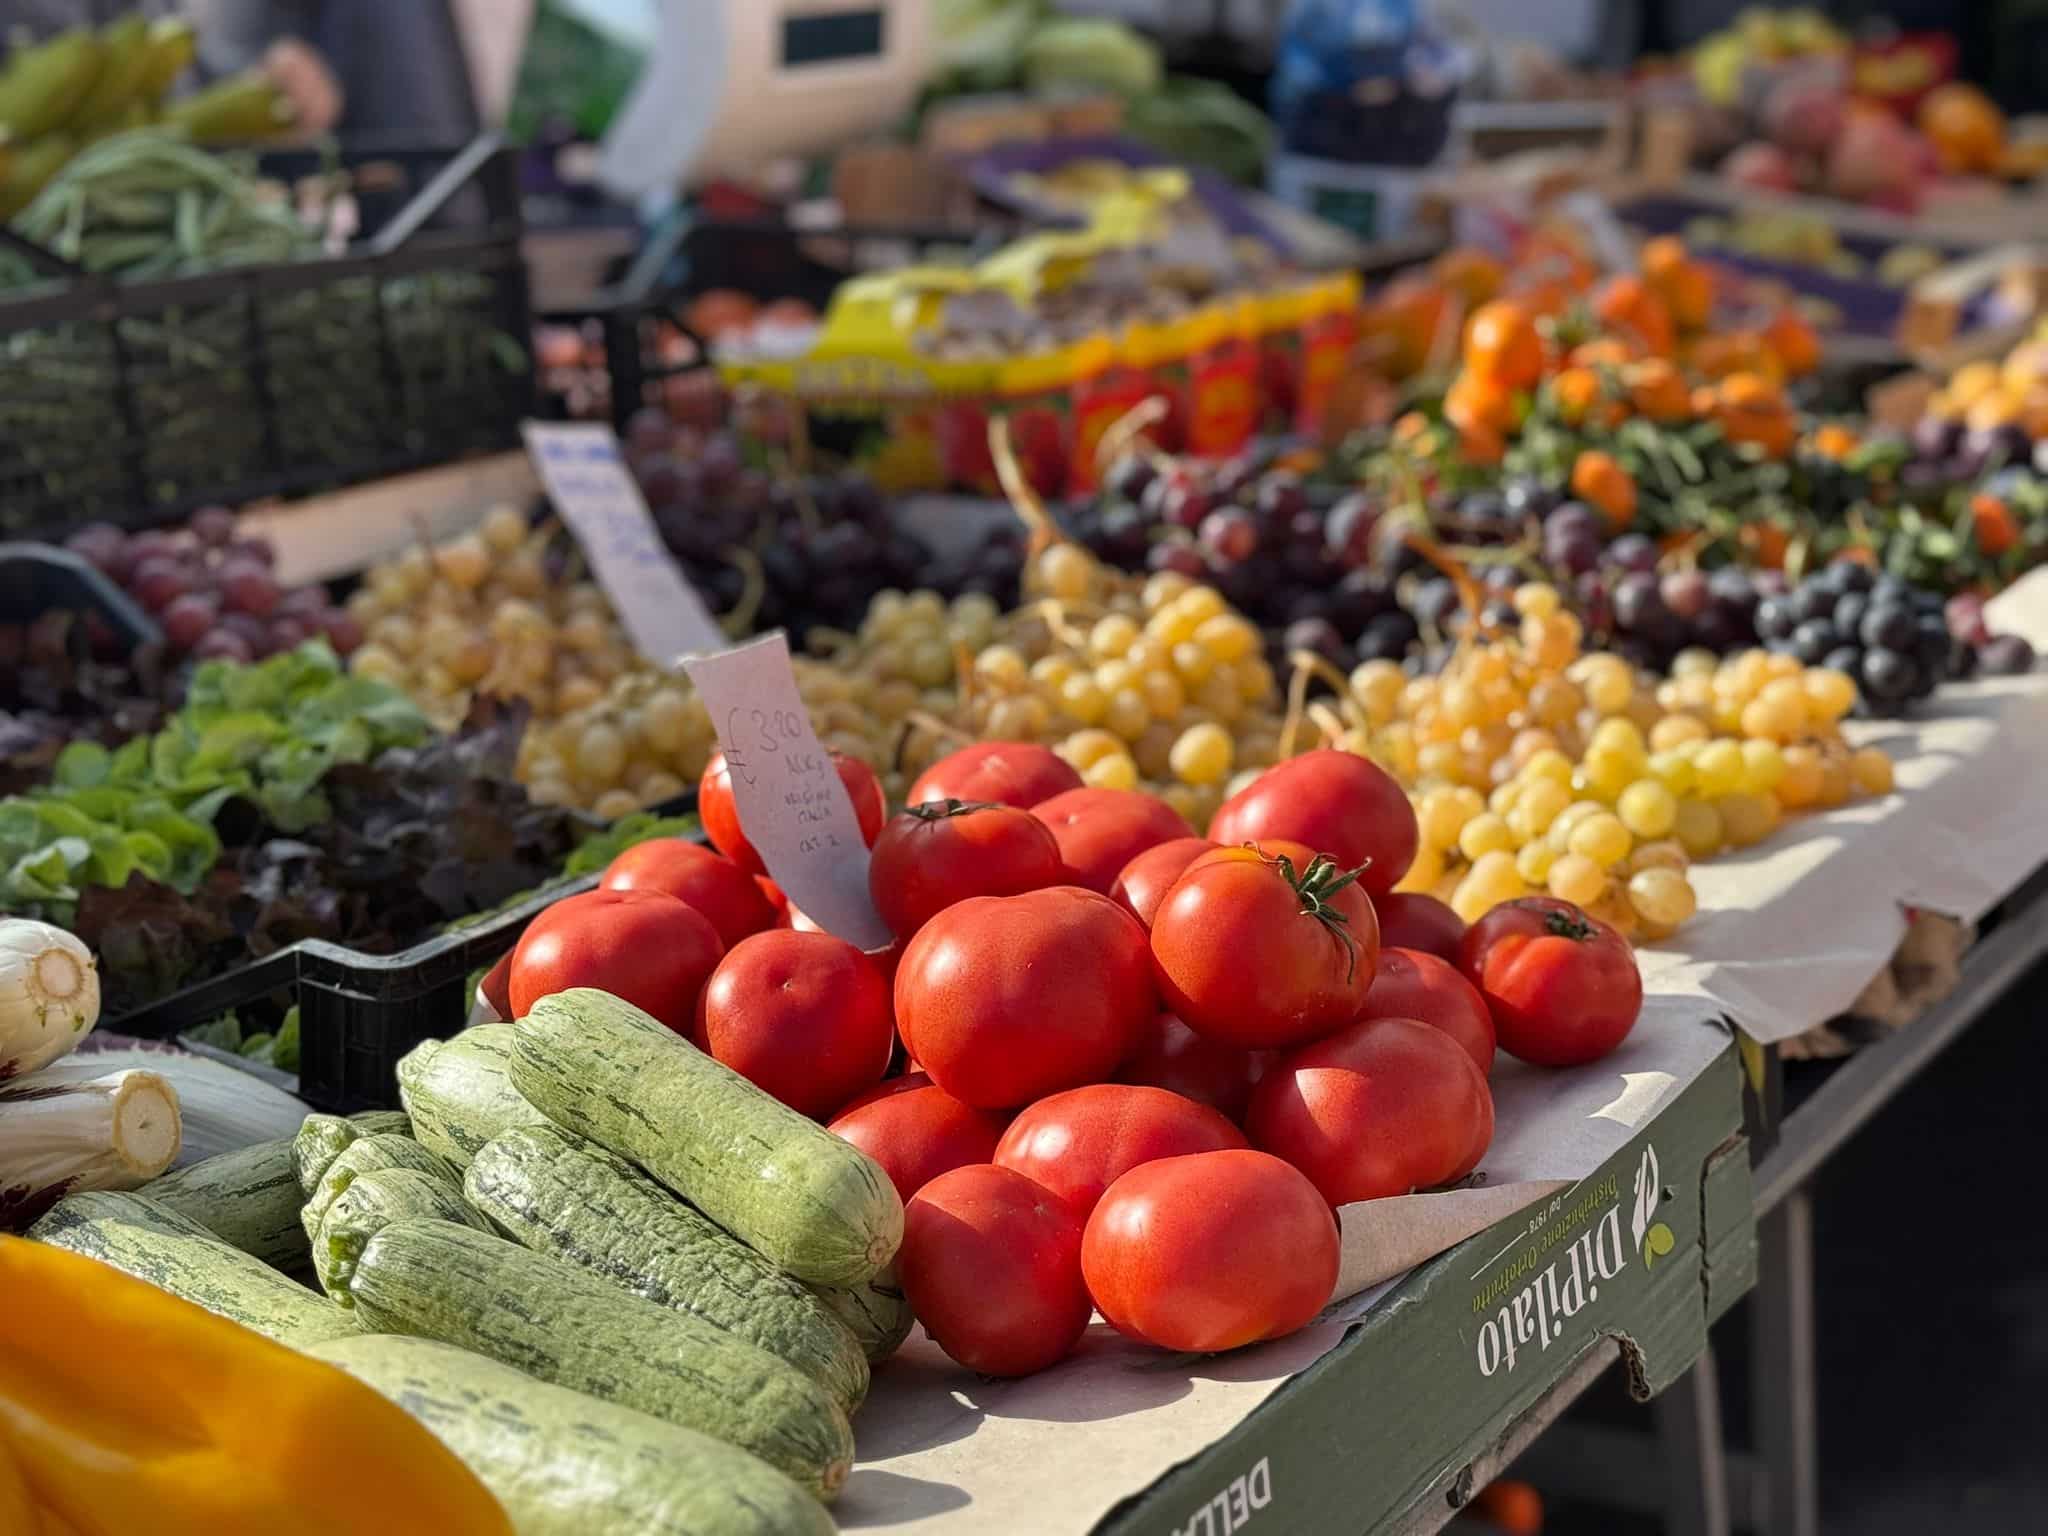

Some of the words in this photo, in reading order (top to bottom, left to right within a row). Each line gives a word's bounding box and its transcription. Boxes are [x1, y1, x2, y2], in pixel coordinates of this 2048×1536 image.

[1528, 1211, 1547, 1235] 1978
[1540, 1173, 1617, 1253] Distribuzione
[1546, 1197, 1561, 1218] Dal
[1472, 1245, 1537, 1313] Ortofrutta
[1477, 1203, 1627, 1377] DiPilato
